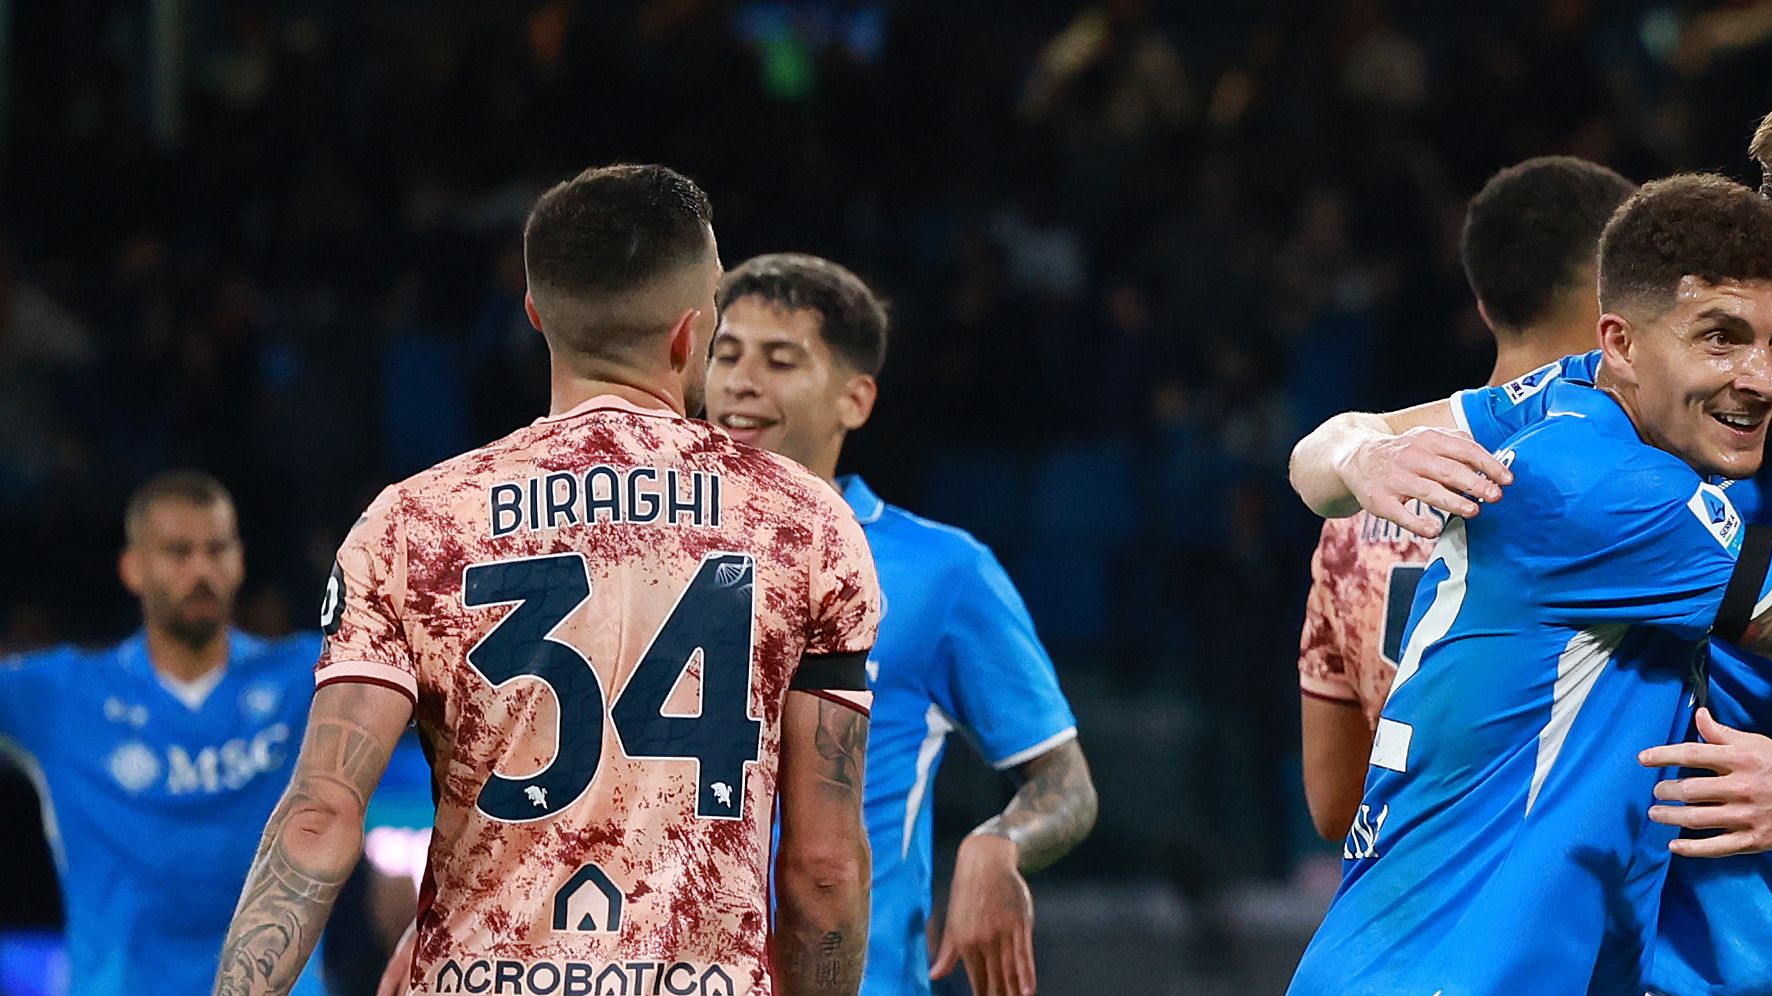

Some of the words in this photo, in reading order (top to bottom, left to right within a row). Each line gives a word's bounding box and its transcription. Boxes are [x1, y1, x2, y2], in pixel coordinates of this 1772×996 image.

[491, 465, 722, 537] BIRAGHI
[462, 551, 764, 821] 34
[167, 723, 290, 795] MSC
[435, 958, 735, 996] ACROBATICA
